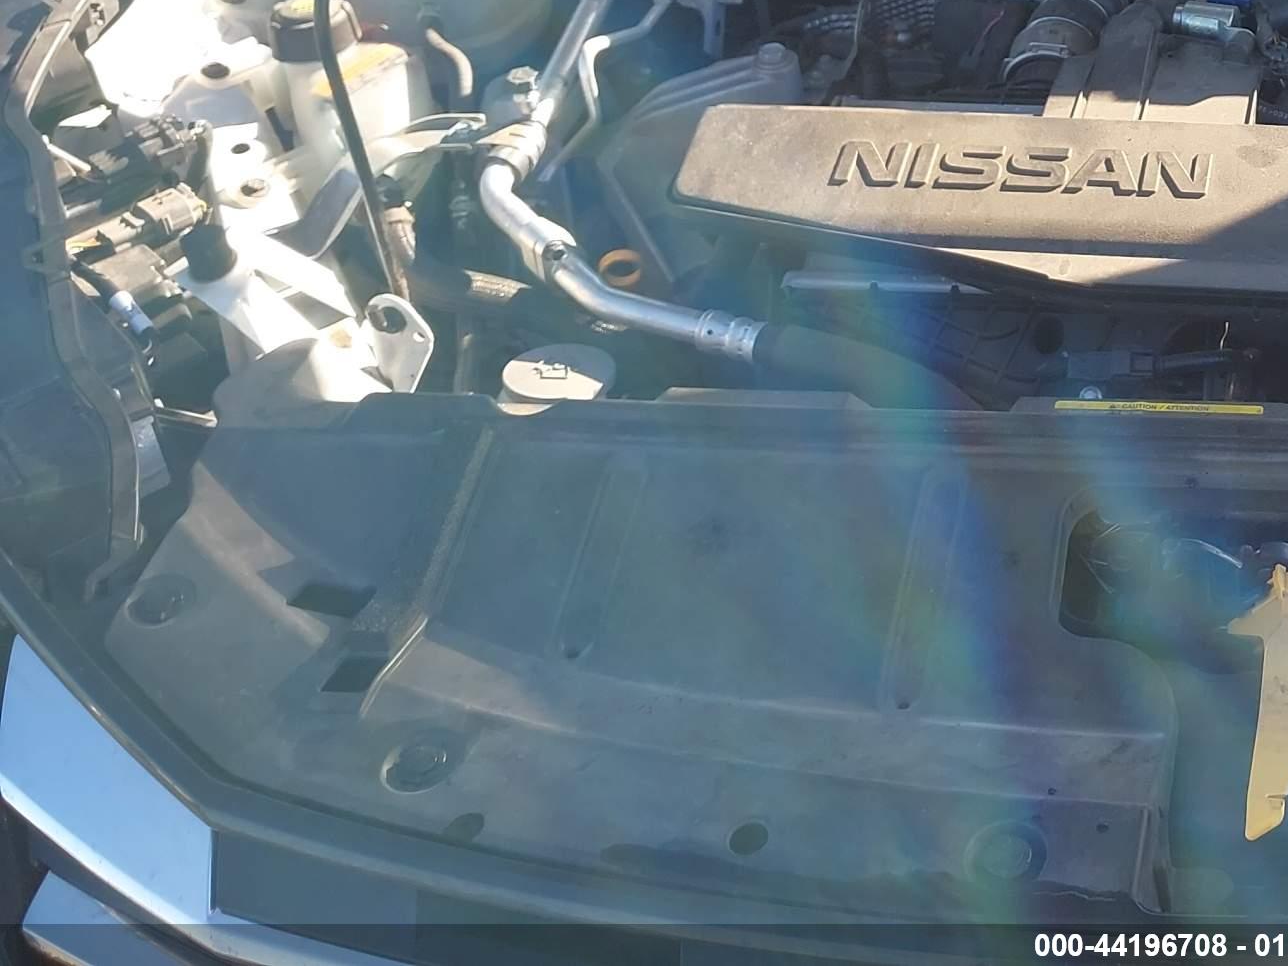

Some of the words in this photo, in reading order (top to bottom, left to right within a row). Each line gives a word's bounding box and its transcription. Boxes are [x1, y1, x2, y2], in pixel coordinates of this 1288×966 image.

[828, 140, 1213, 199] NISSAN
[1122, 402, 1157, 411] CAUTION
[1166, 404, 1209, 412] ATTENTION
